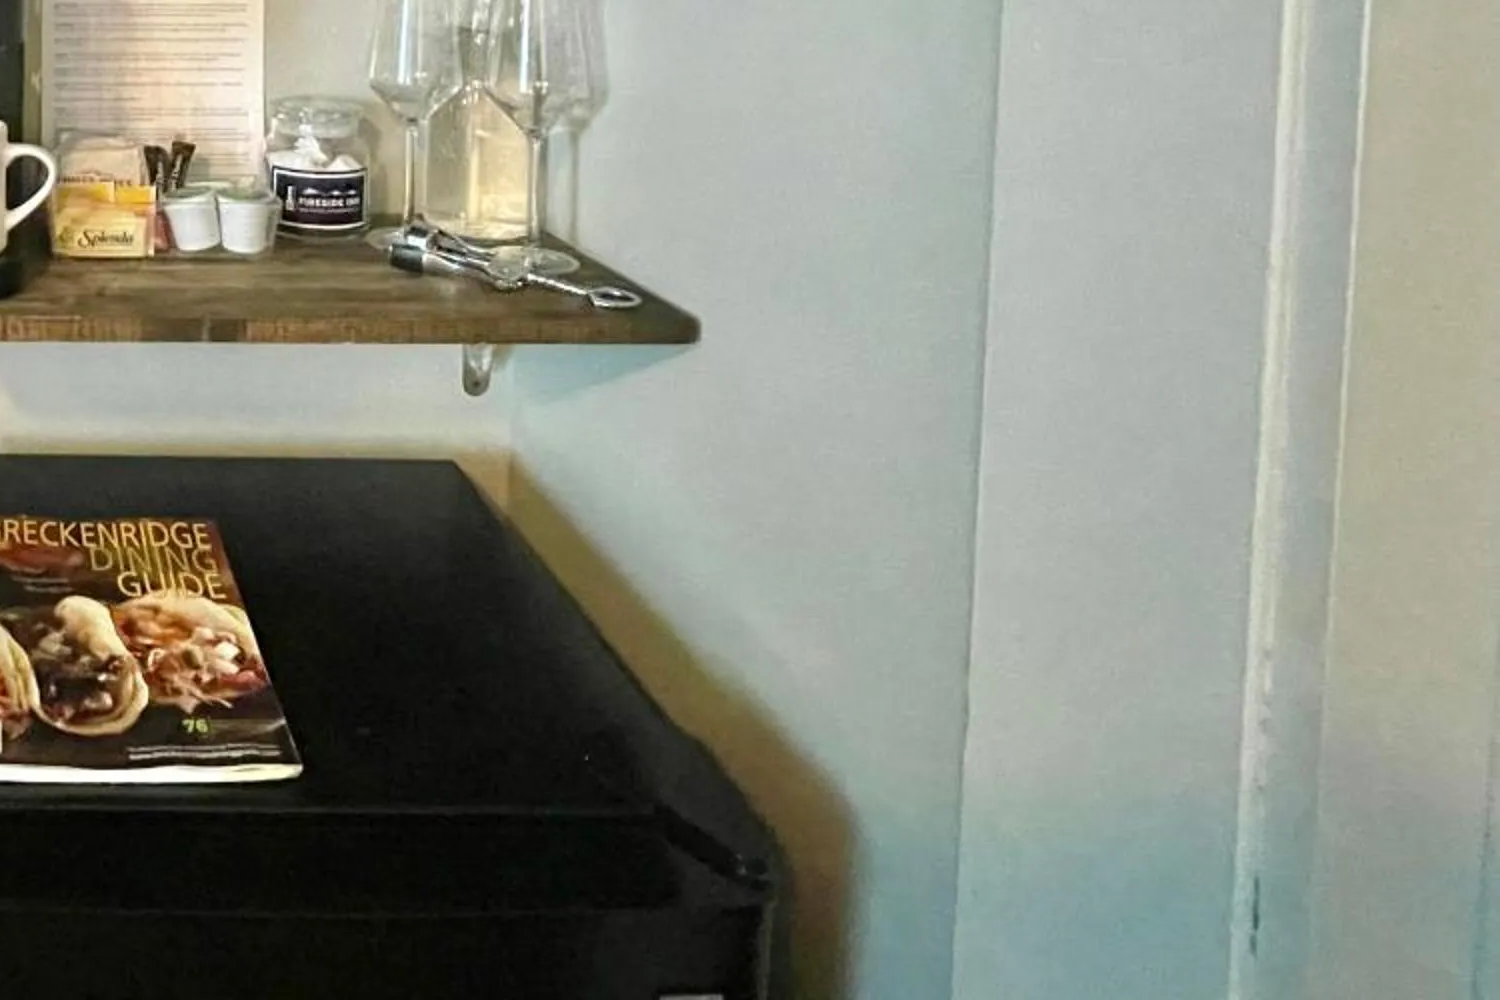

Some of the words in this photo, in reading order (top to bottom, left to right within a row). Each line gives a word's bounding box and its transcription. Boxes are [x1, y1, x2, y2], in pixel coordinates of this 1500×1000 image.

[77, 229, 134, 249] Splenda
[88, 548, 219, 573] DINING
[116, 571, 227, 600] GUIDE
